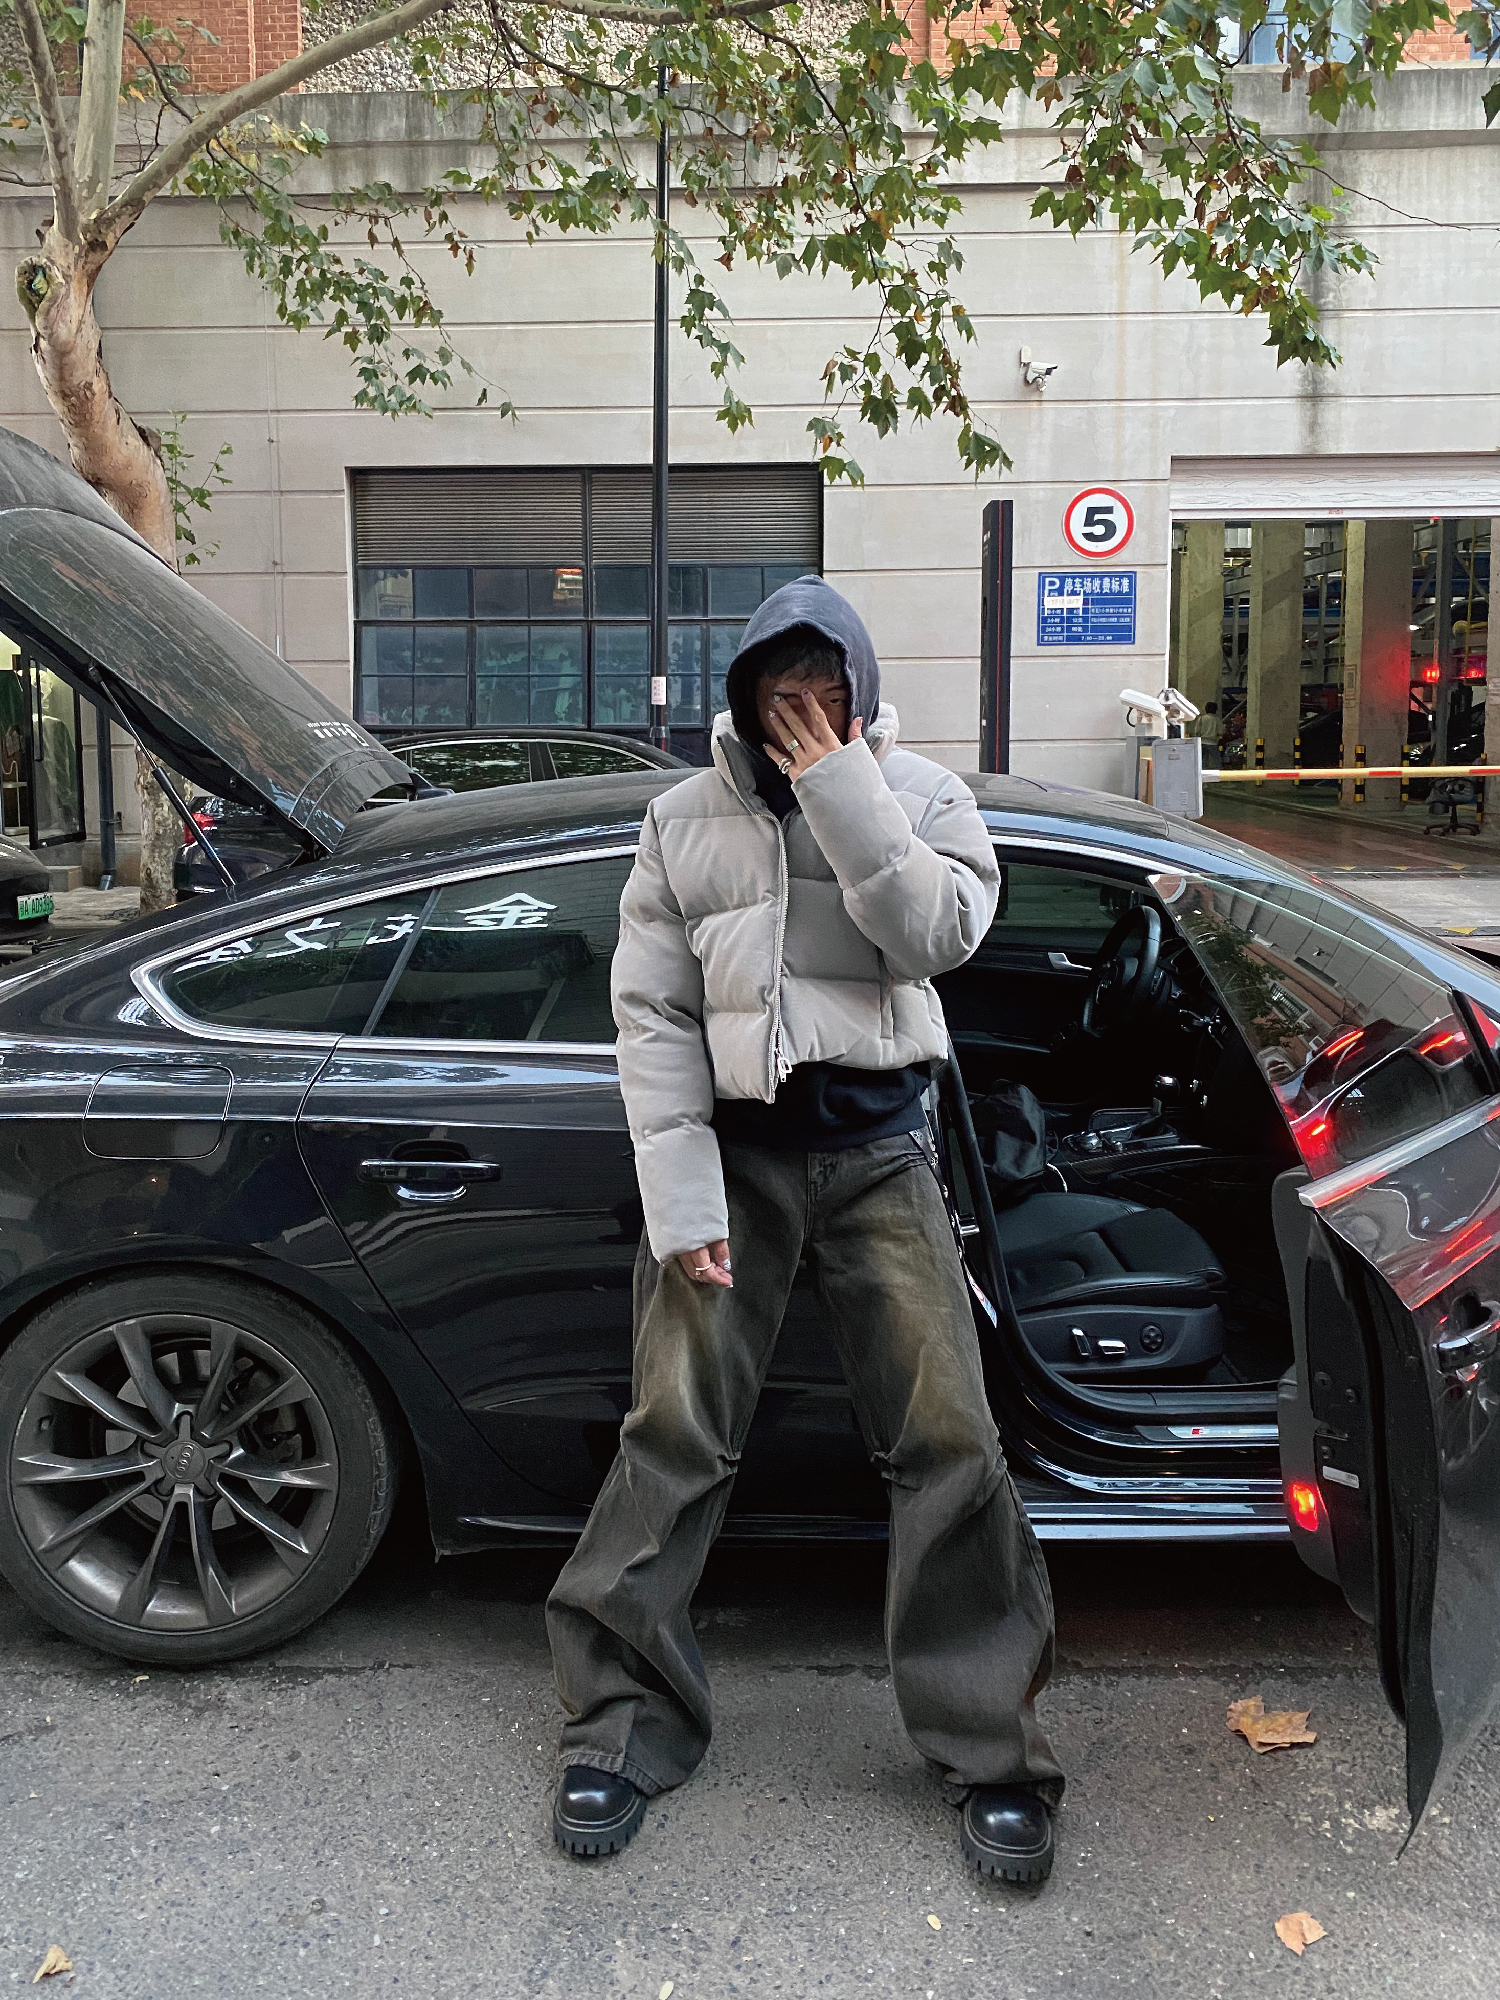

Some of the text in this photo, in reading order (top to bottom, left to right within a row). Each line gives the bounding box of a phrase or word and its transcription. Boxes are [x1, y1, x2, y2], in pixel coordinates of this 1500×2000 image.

[1081, 506, 1117, 542] 5
[1045, 578, 1060, 596] P
[1065, 577, 1130, 594] 停车场收费标准
